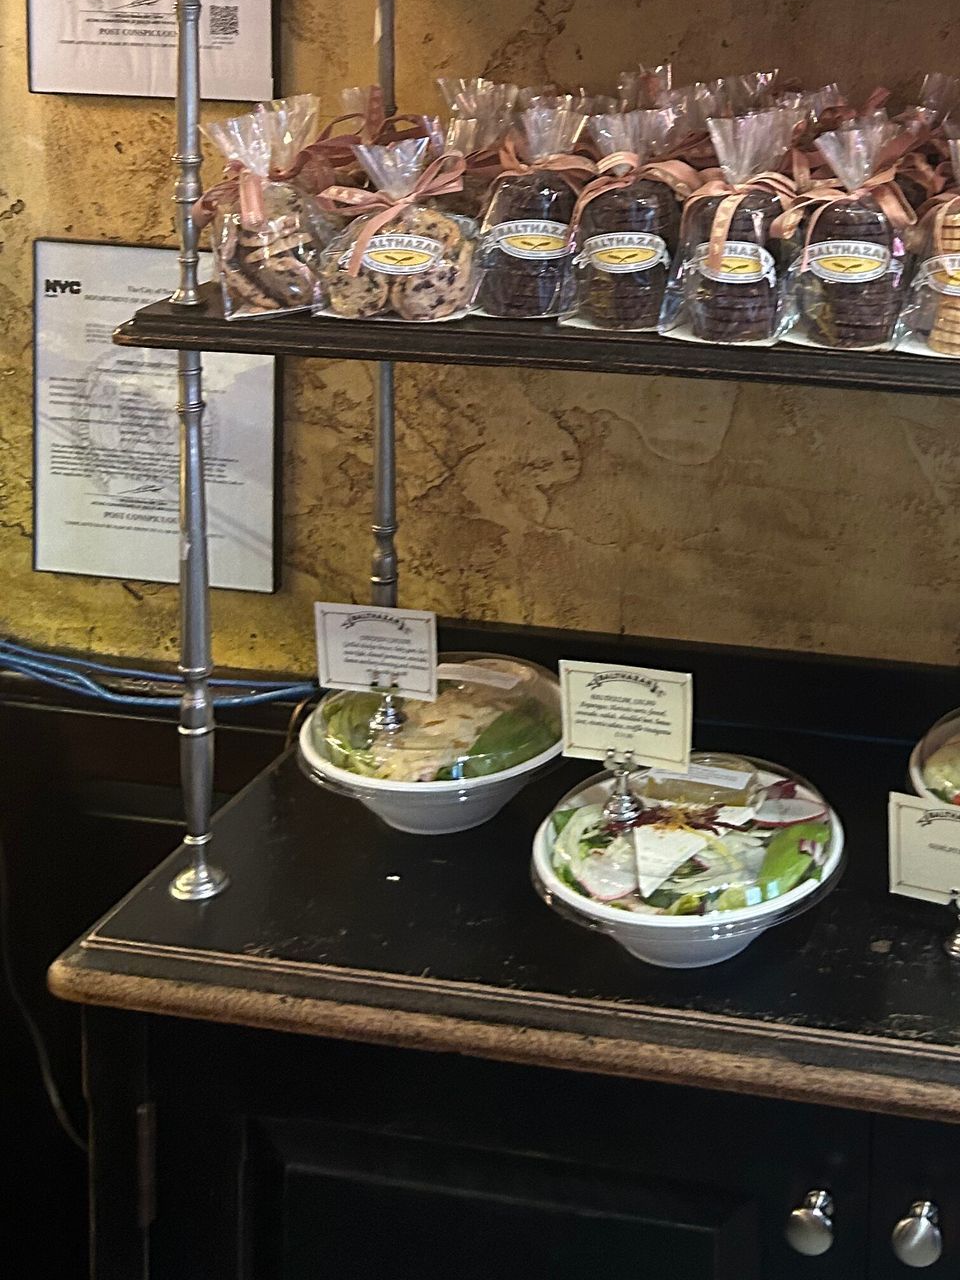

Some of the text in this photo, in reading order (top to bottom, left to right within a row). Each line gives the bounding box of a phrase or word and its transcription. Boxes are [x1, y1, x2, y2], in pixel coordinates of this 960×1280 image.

[99, 28, 178, 38] POST CONSPICUOU
[499, 224, 567, 237] BALTHAZA
[368, 236, 441, 255] ALTHAZAR
[45, 279, 82, 295] NYC
